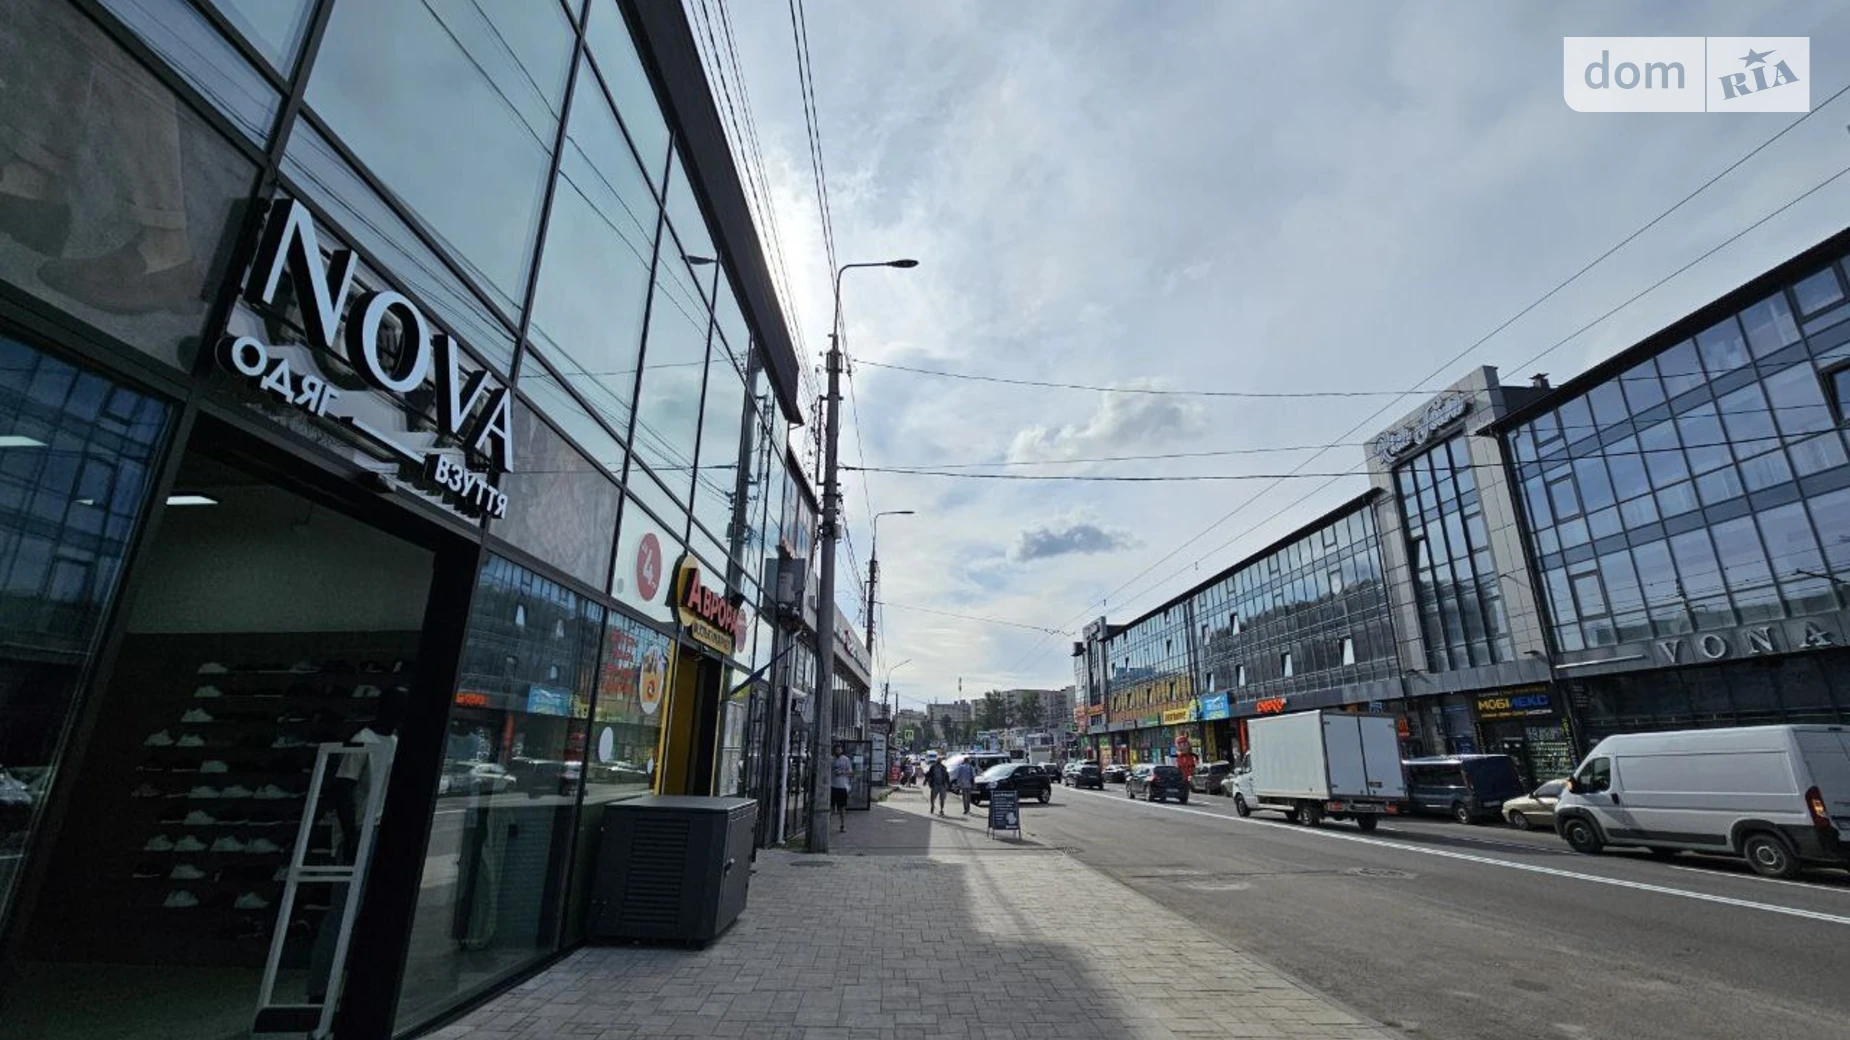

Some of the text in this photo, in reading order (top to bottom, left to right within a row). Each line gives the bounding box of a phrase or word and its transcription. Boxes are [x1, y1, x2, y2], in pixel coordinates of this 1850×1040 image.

[231, 335, 509, 519] ОДЯГ ВЗУТТЯ
[260, 197, 514, 473] NOVA
[1658, 621, 1832, 663] VONA
